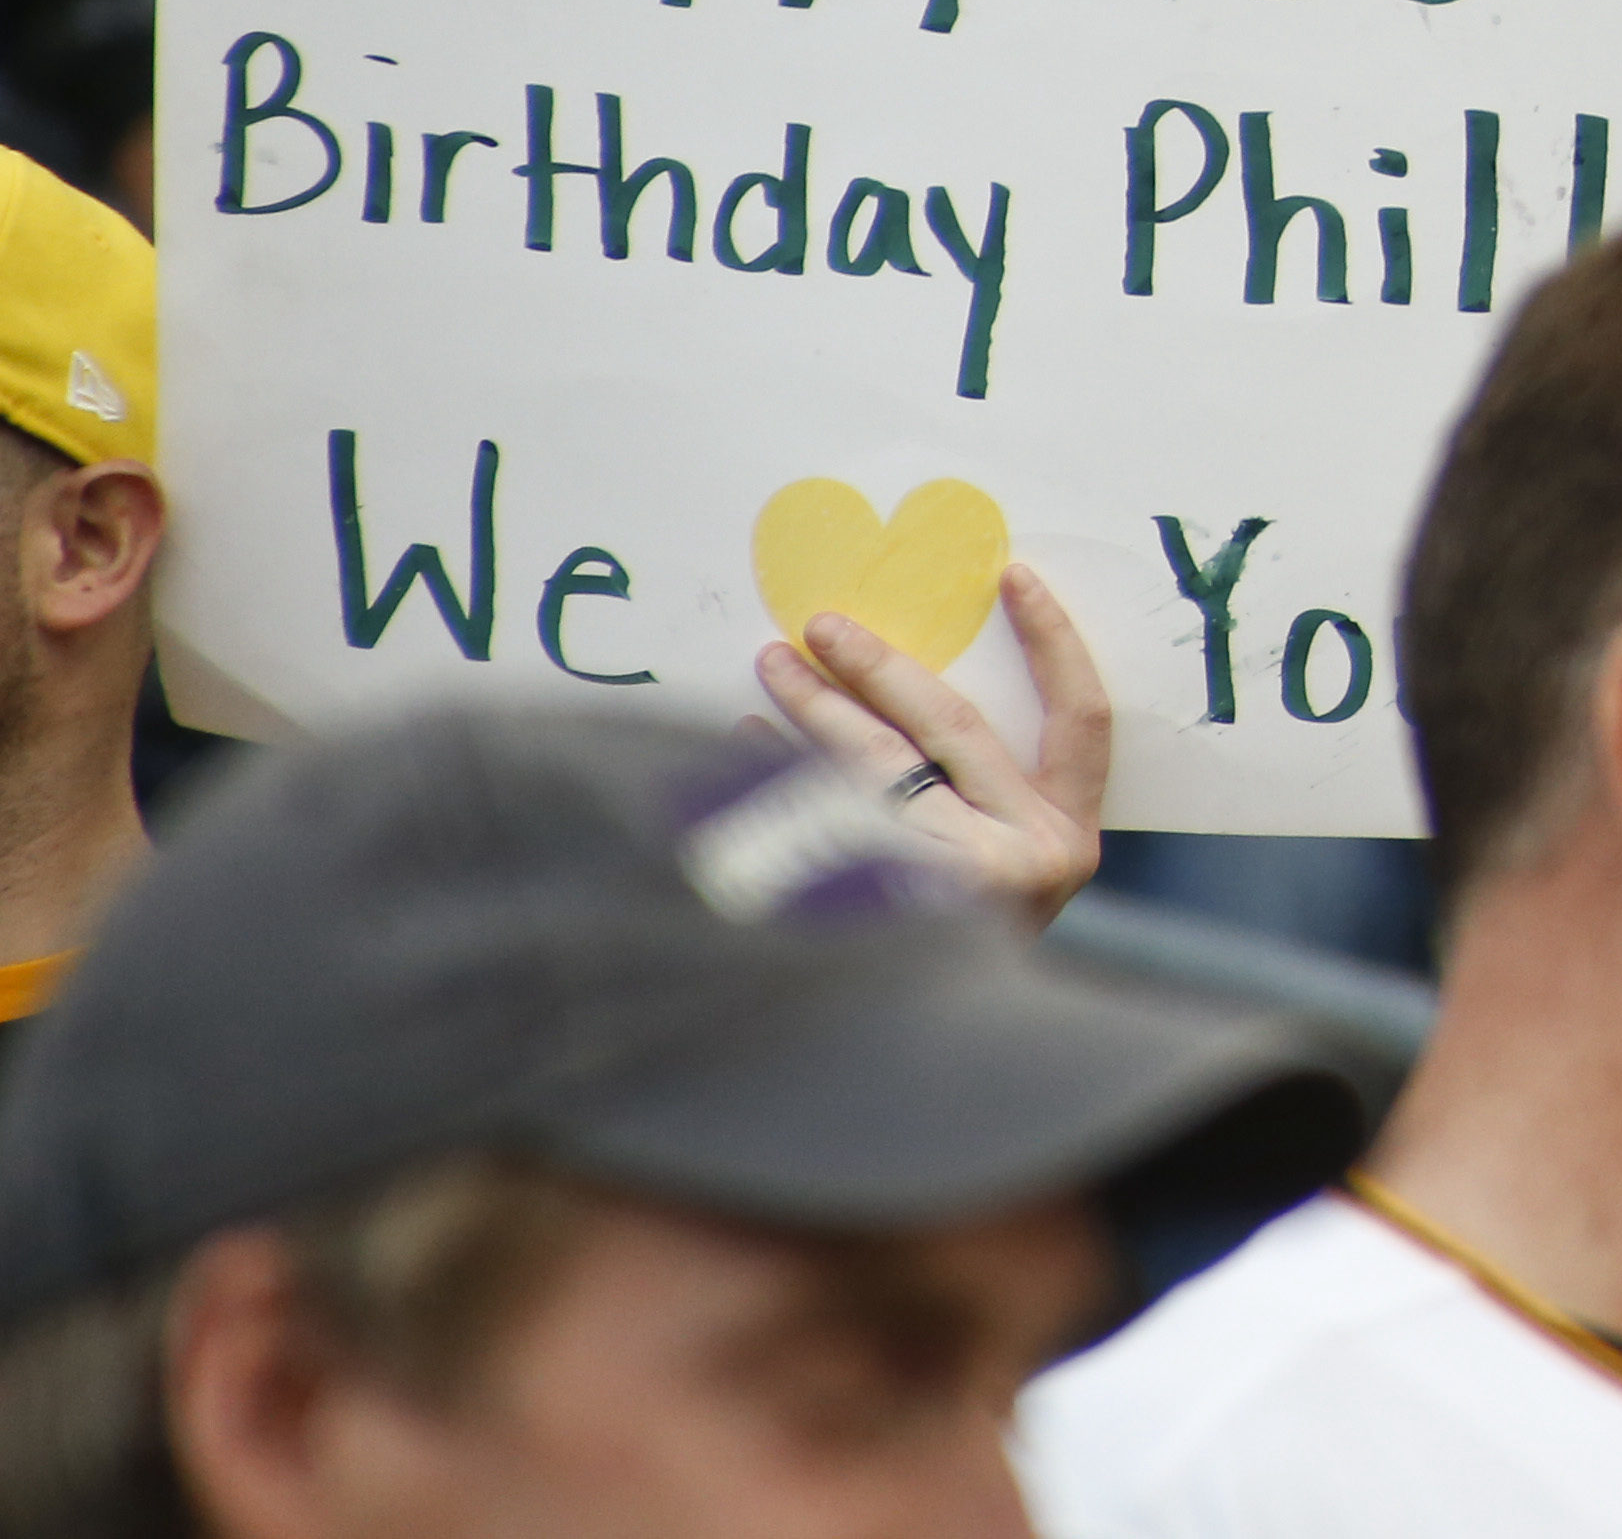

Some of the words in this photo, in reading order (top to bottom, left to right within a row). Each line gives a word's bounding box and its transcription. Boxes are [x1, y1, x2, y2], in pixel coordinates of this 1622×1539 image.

[214, 31, 1011, 400] Birthday
[328, 429, 659, 685] We
[1151, 515, 1412, 724] Yo
